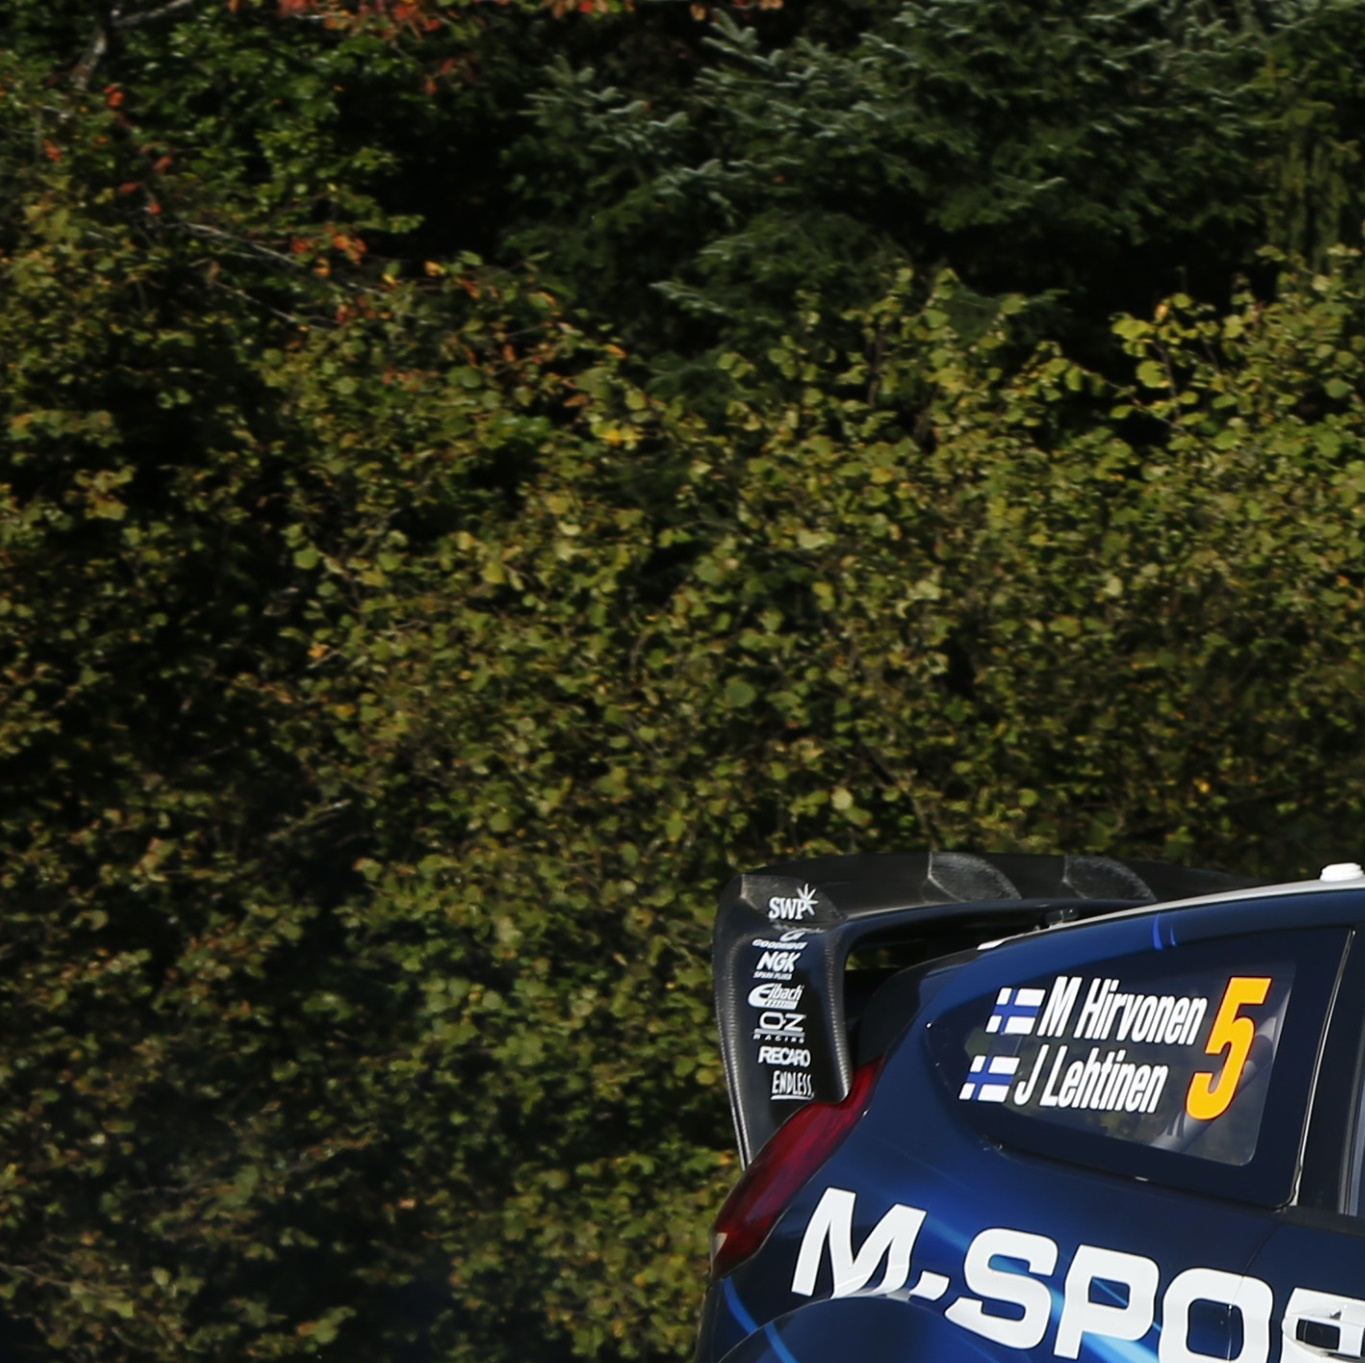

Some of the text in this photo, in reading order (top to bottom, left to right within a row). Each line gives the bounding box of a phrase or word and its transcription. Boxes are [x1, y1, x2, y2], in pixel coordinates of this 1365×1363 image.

[768, 896, 808, 920] SWP
[756, 951, 801, 972] NGK
[1037, 976, 1208, 1045] M Hirvonen
[757, 1046, 811, 1067] RECARO
[1186, 976, 1273, 1121] 5
[771, 1070, 812, 1097] ENDLESS
[1013, 1044, 1169, 1114] J Lehtinen
